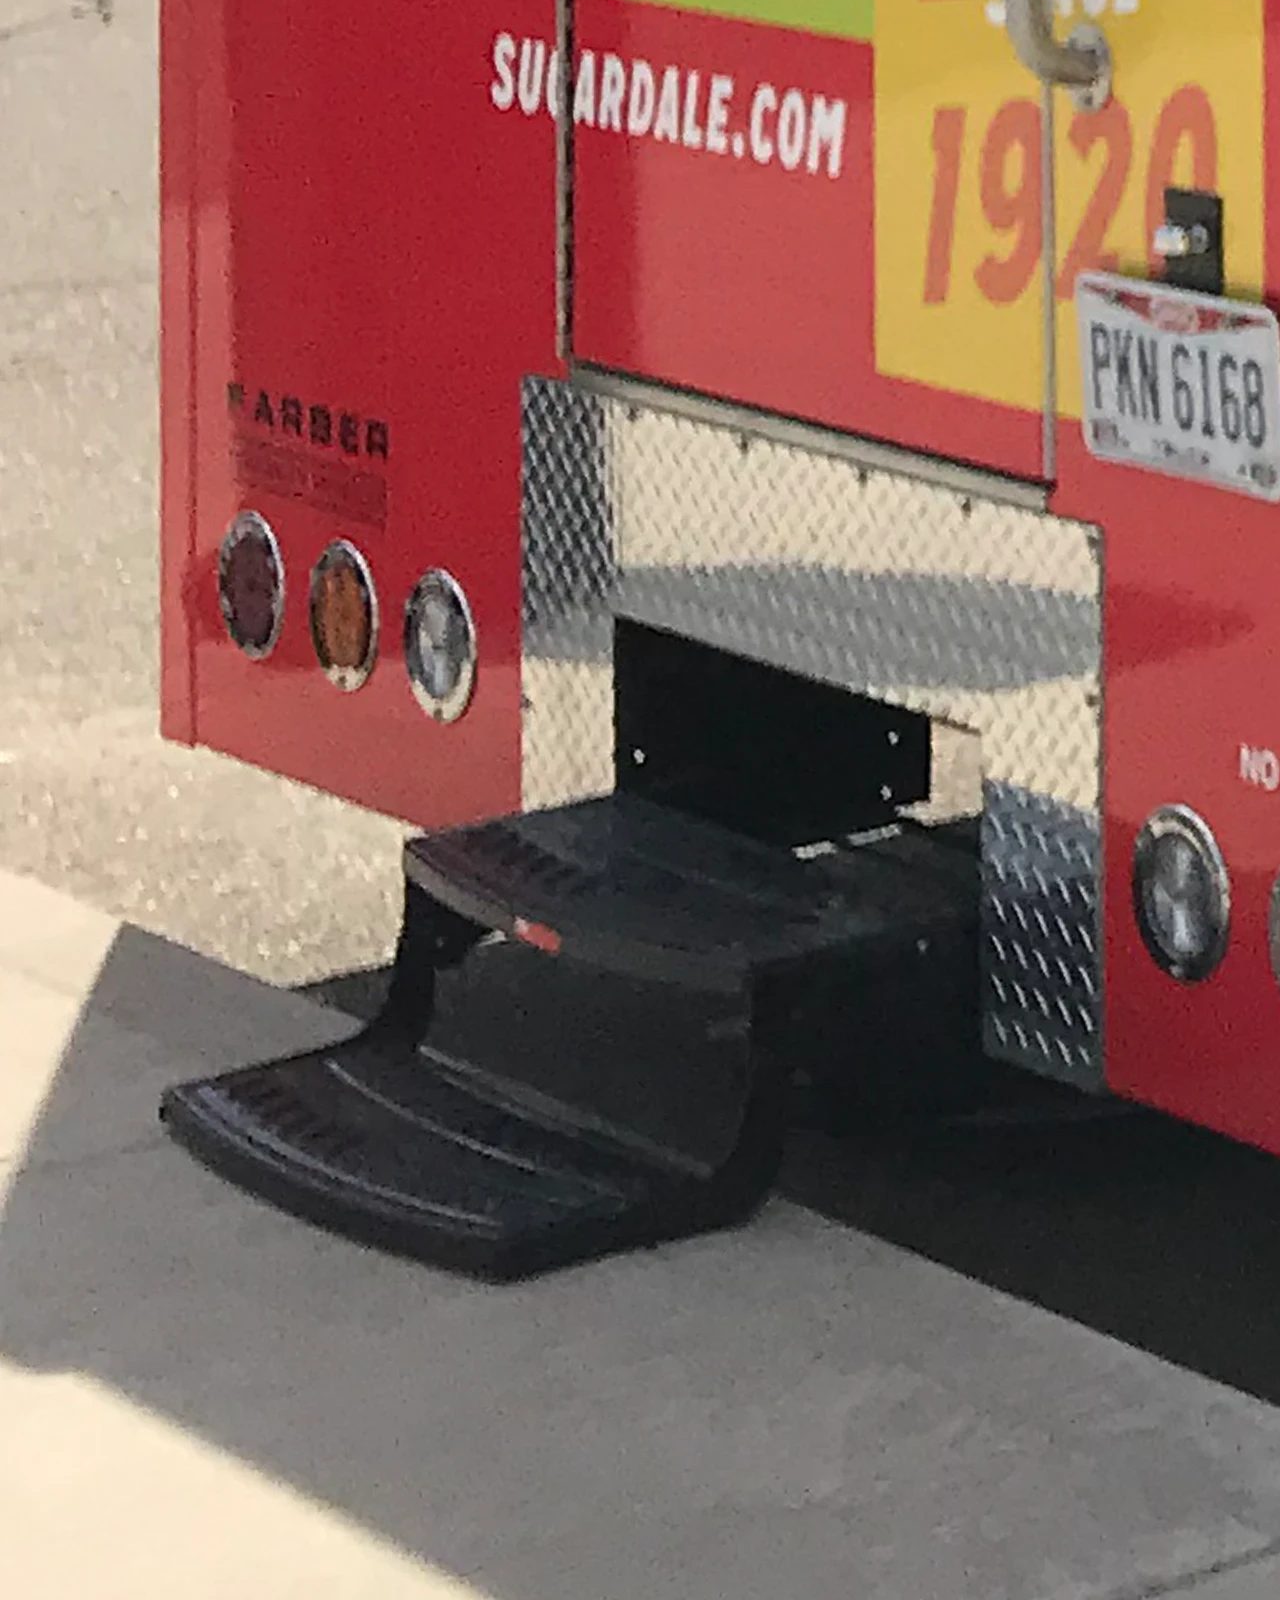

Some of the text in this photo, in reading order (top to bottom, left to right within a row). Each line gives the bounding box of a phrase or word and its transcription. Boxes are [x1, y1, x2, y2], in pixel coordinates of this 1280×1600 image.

[921, 84, 1218, 306] 1920
[1091, 320, 1267, 450] PKN 6168
[1239, 742, 1280, 792] NO
